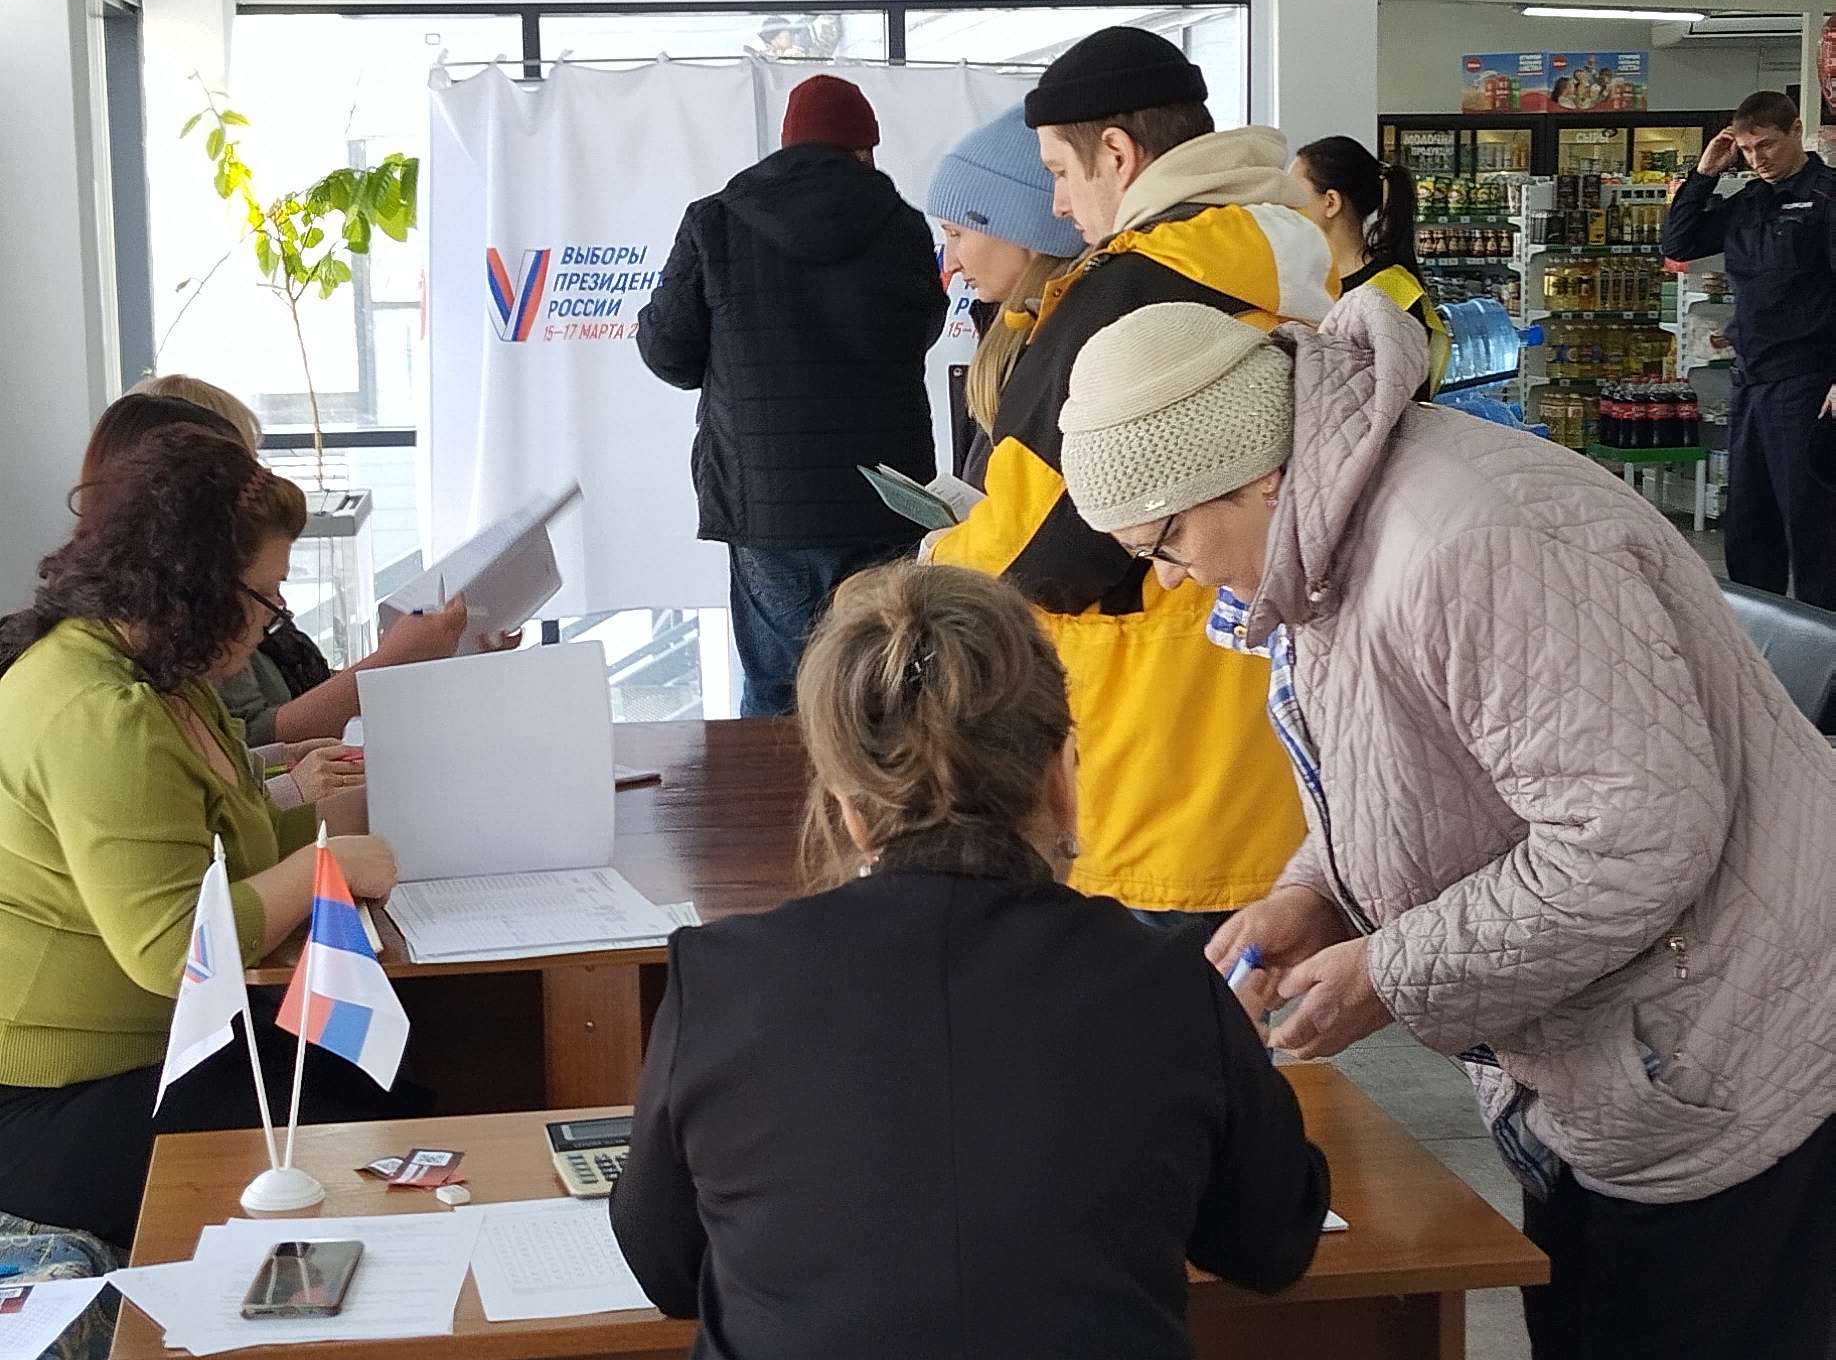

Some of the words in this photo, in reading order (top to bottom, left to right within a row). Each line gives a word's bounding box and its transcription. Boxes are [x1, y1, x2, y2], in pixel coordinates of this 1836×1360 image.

[560, 245, 648, 265] ВЫБОРЫ
[553, 270, 665, 294] ПРЕЗИДЕНТ
[547, 297, 623, 319] РОССИИ
[580, 322, 624, 340] МАРТА
